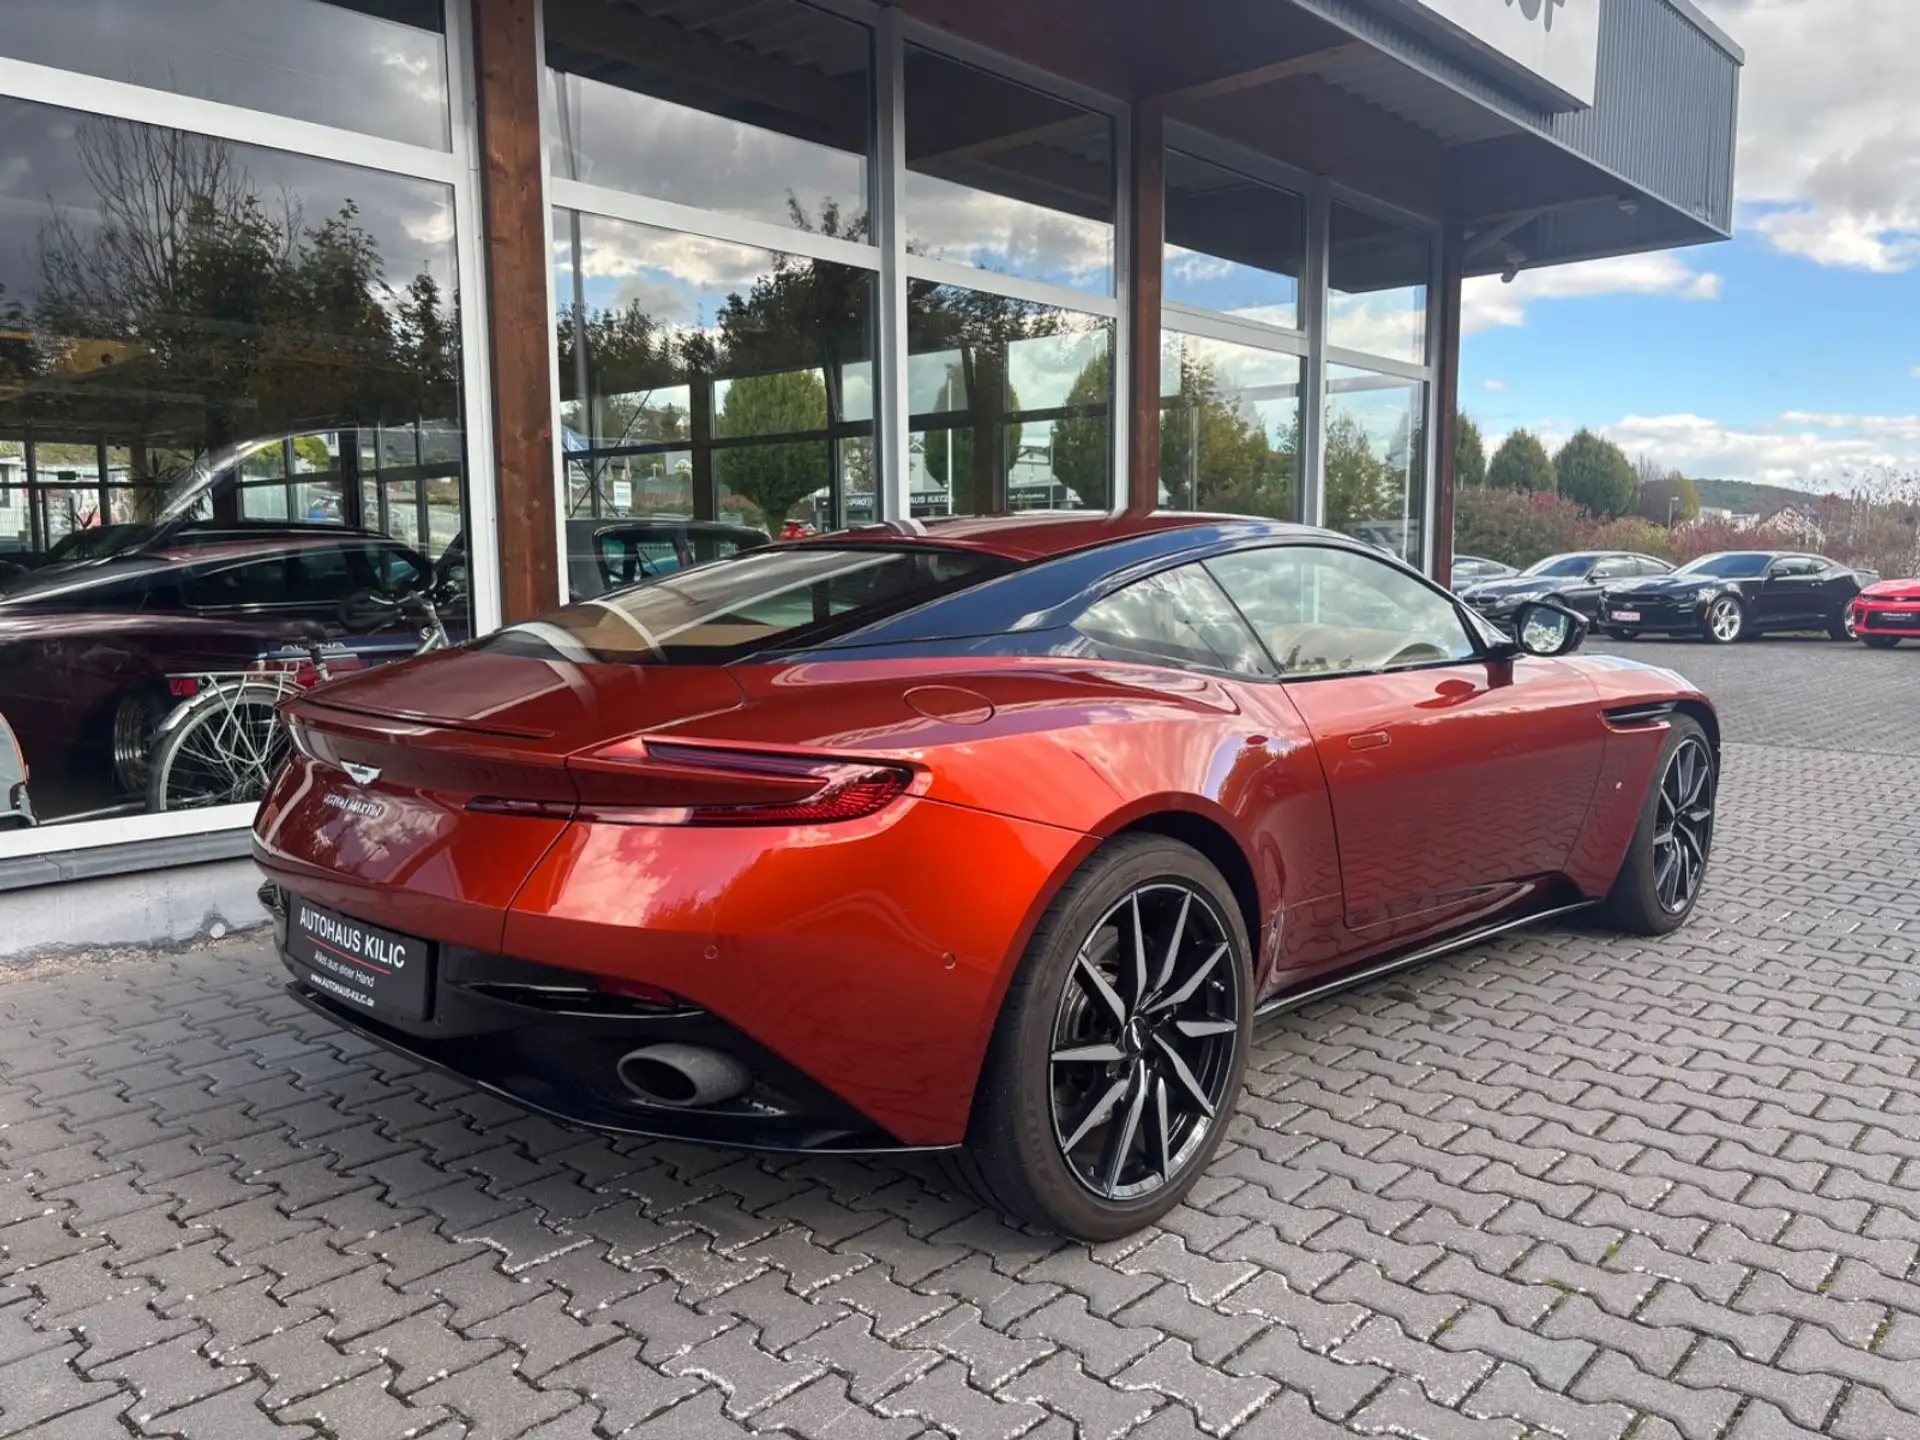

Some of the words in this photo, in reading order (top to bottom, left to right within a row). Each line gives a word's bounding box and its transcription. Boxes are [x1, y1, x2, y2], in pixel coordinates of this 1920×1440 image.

[300, 907, 360, 952] AUTOHAUS
[364, 934, 405, 968] KILIC
[355, 970, 375, 987] Hand
